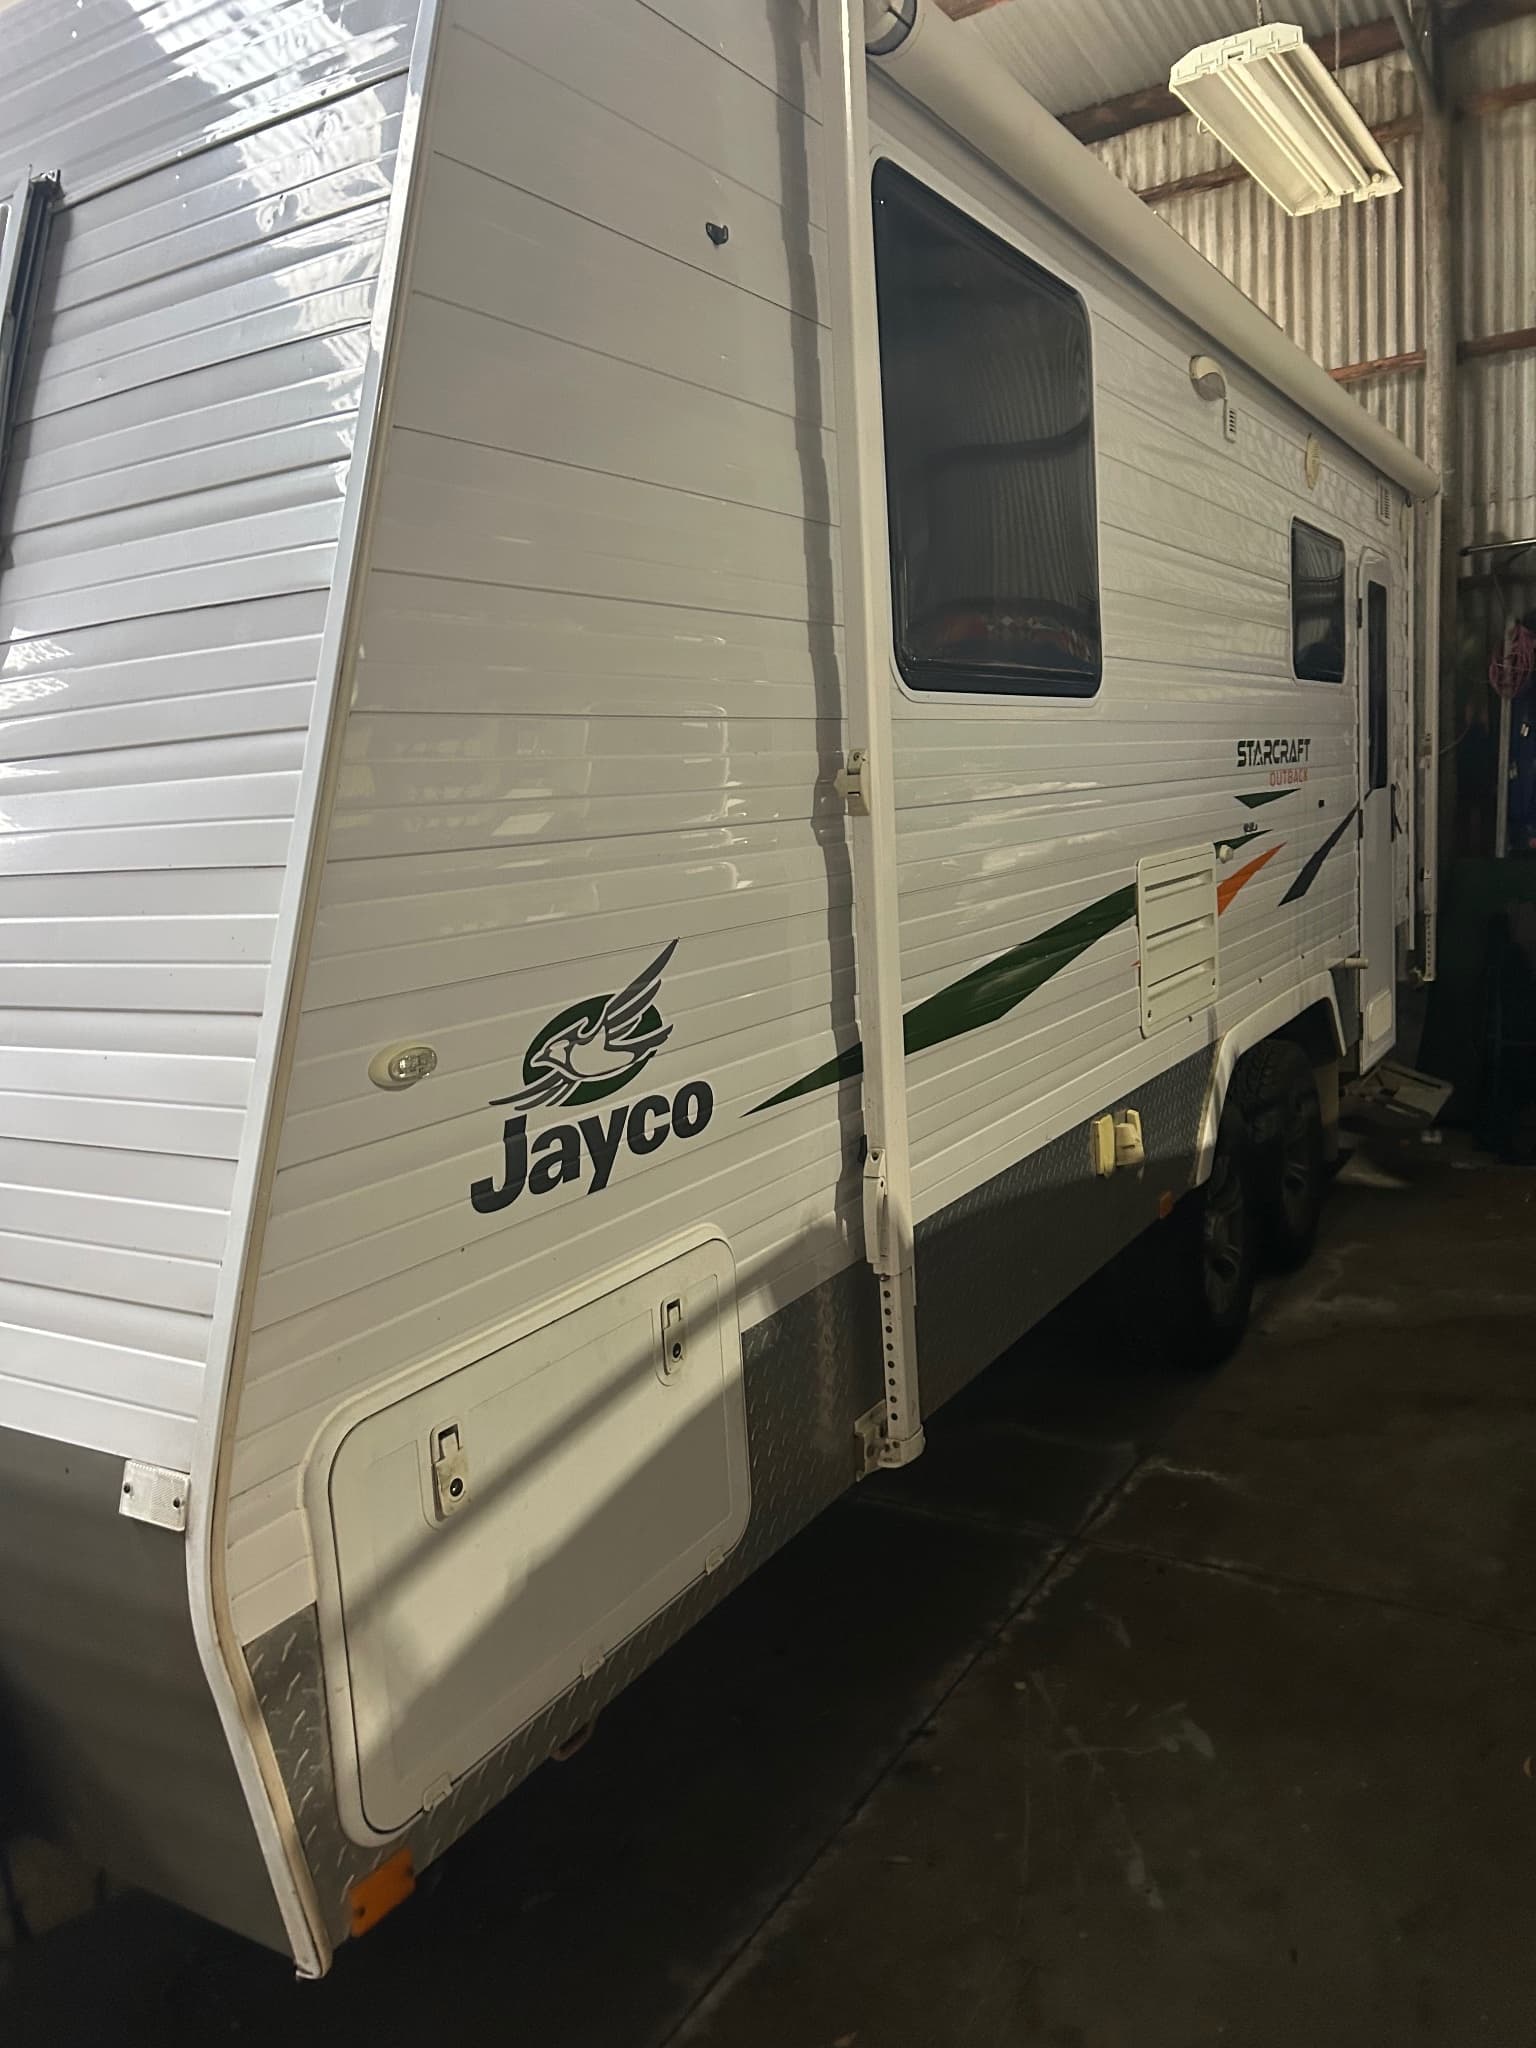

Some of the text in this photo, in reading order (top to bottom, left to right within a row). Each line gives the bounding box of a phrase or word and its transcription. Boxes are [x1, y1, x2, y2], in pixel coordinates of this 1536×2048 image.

[1237, 738, 1311, 767] STARCRAFT
[1269, 768, 1308, 787] OUTBACK
[470, 1080, 714, 1214] Jayco
